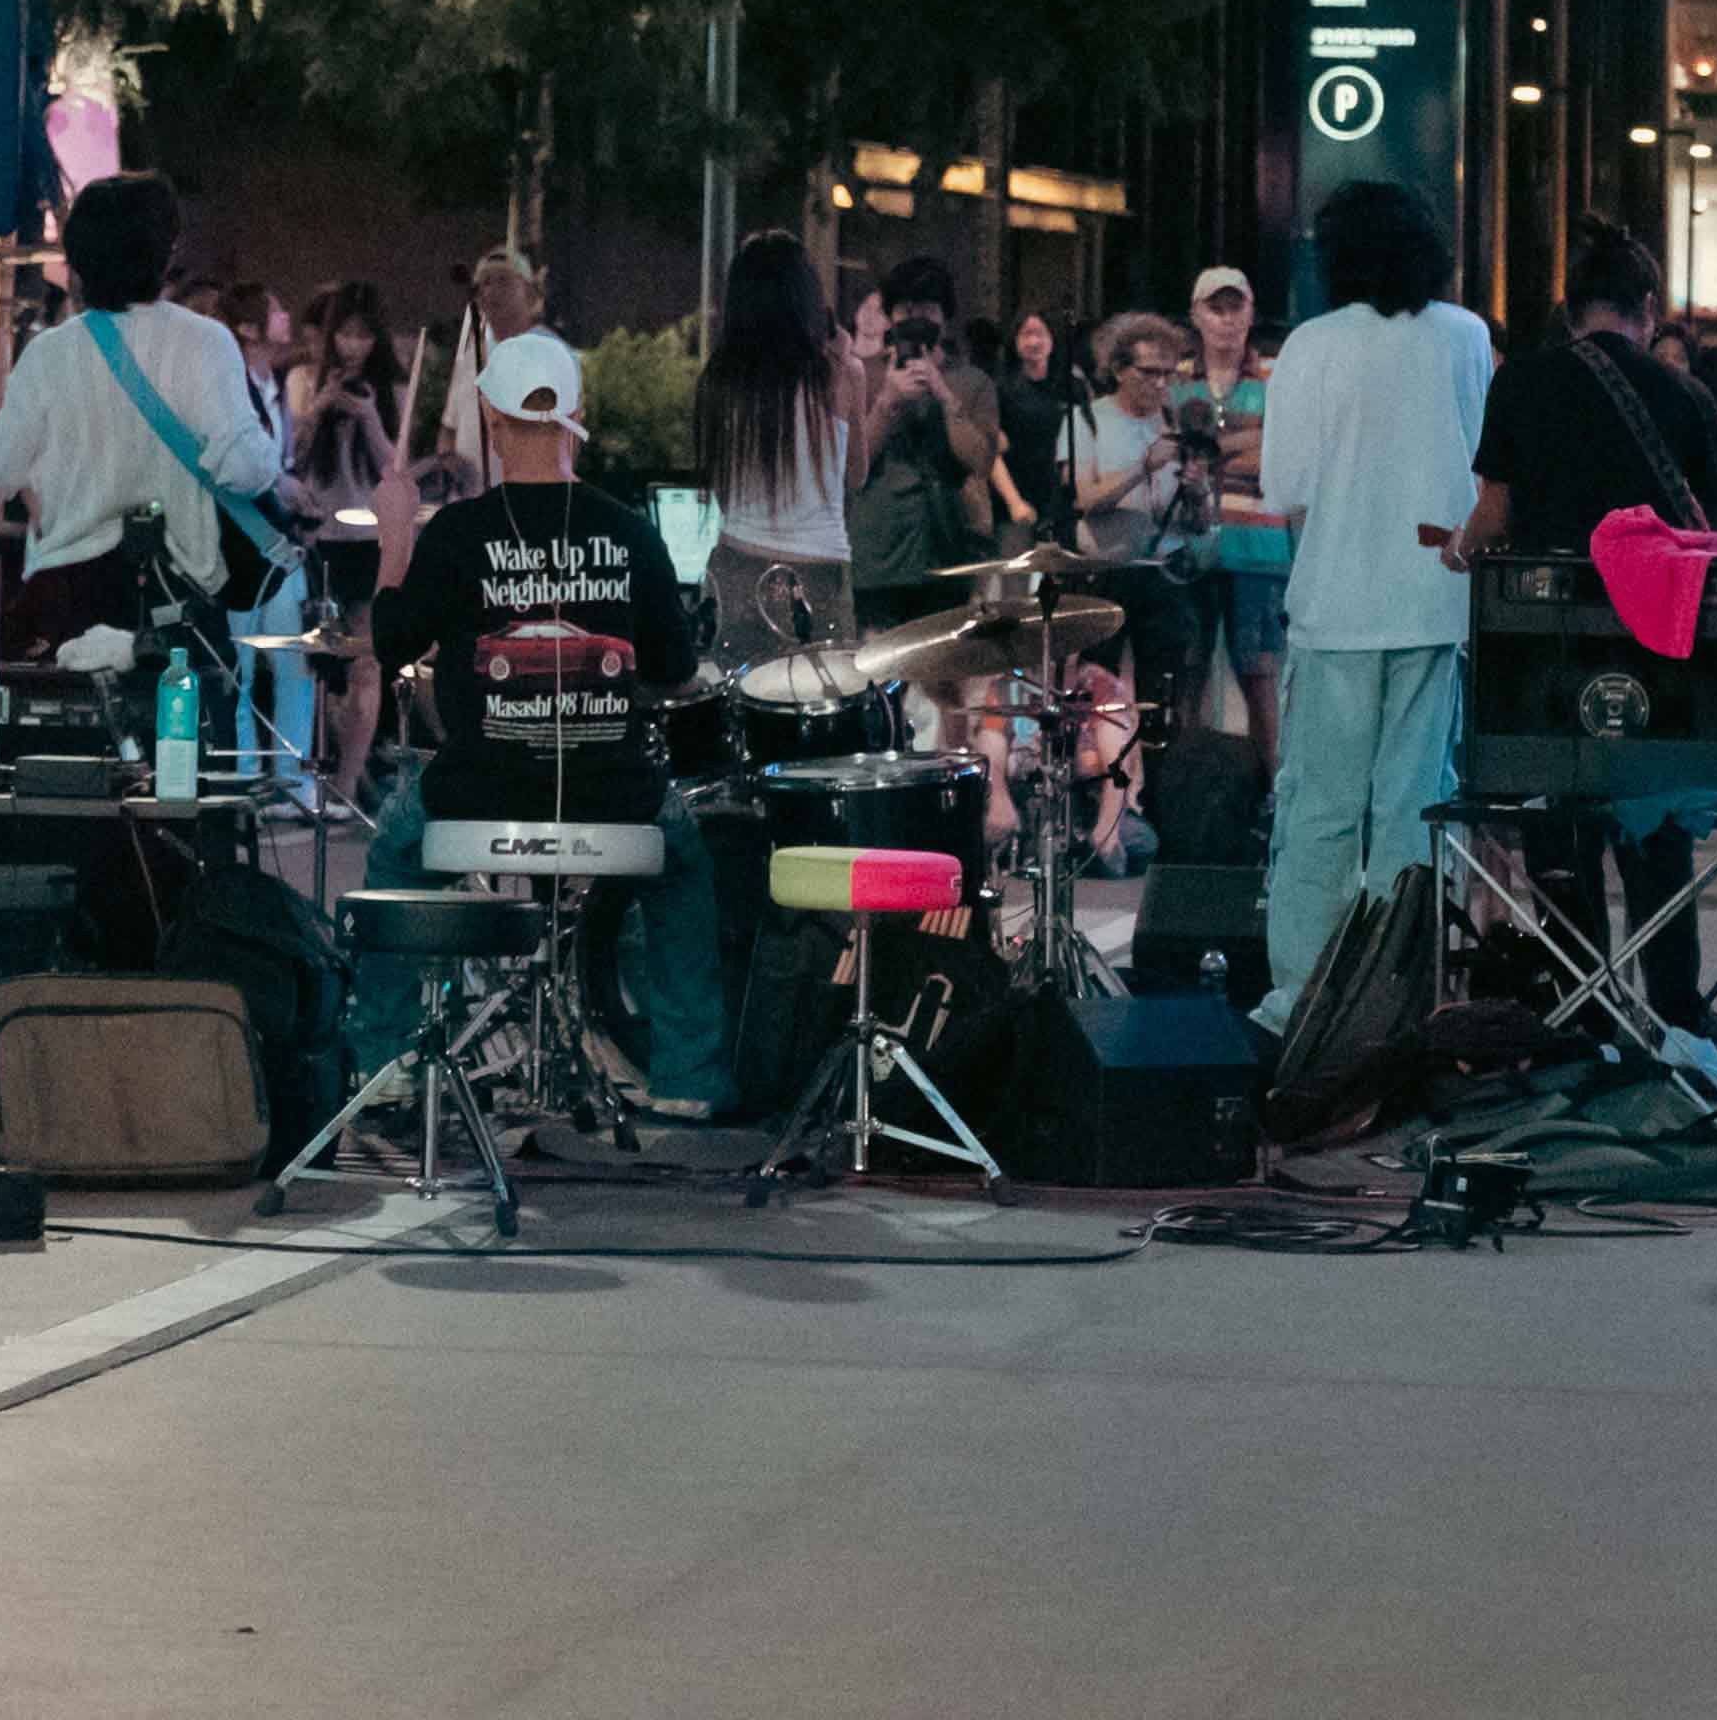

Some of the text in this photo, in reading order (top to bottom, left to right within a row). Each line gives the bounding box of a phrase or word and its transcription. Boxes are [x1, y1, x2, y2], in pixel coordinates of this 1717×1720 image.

[1334, 83, 1359, 124] P
[484, 535, 630, 577] Wake Up The
[482, 570, 631, 614] Neighborhood
[486, 692, 552, 718] Masashi
[581, 691, 630, 716] Turbo
